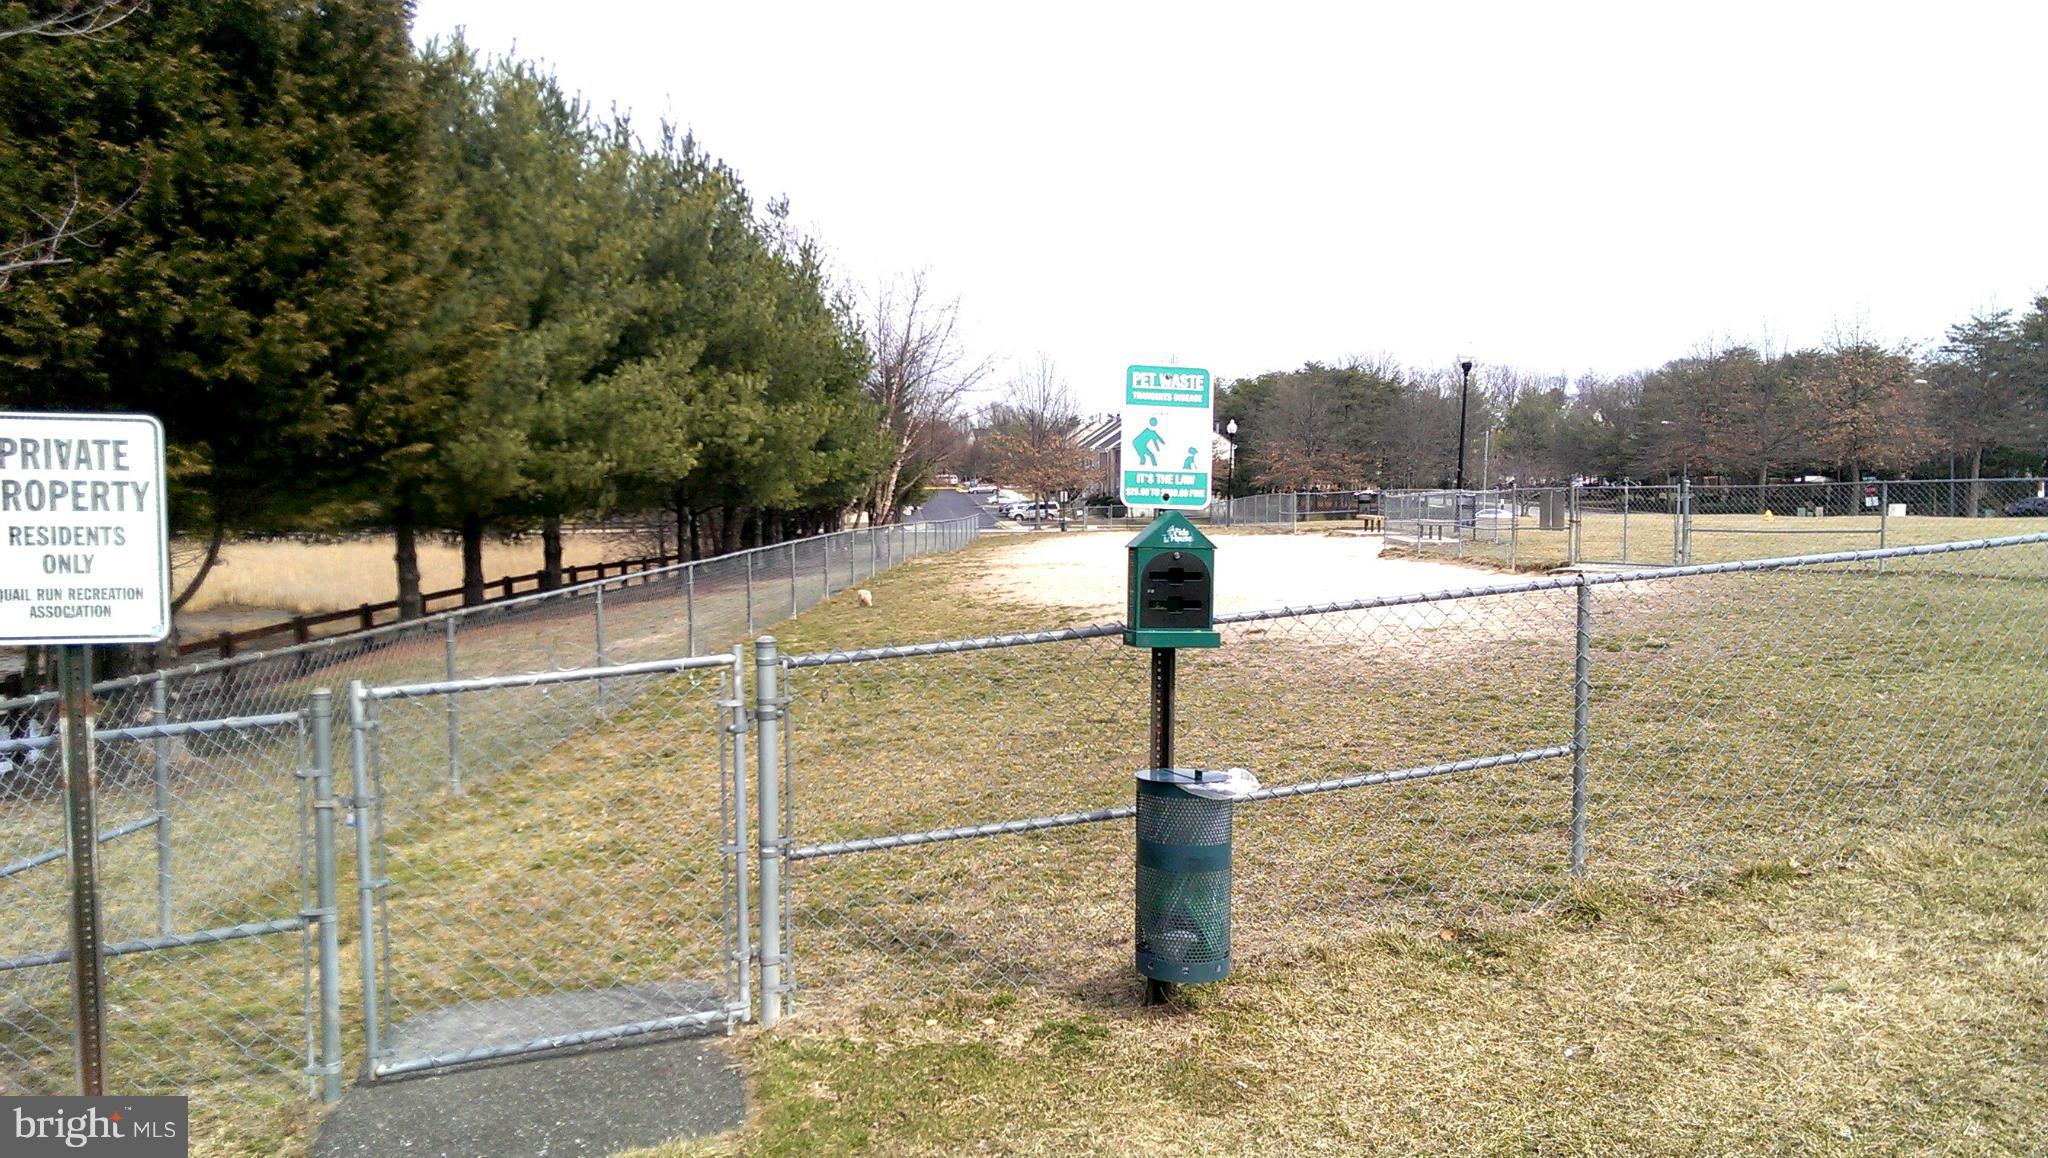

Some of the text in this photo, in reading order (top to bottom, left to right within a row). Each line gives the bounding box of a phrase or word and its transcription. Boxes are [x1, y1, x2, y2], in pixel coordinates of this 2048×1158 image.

[1132, 372, 1204, 391] PET WASTE
[0, 437, 129, 471] PRIVATE
[1136, 473, 1195, 485] IT'S THE LAW
[0, 479, 149, 512] ROPERTY
[1150, 487, 1160, 497] TO
[9, 526, 126, 547] RESIDENTS
[42, 554, 94, 575] ONLY
[37, 588, 62, 601] RUN
[68, 587, 144, 601] RECREATION
[30, 605, 112, 619] ASSOCIATION
